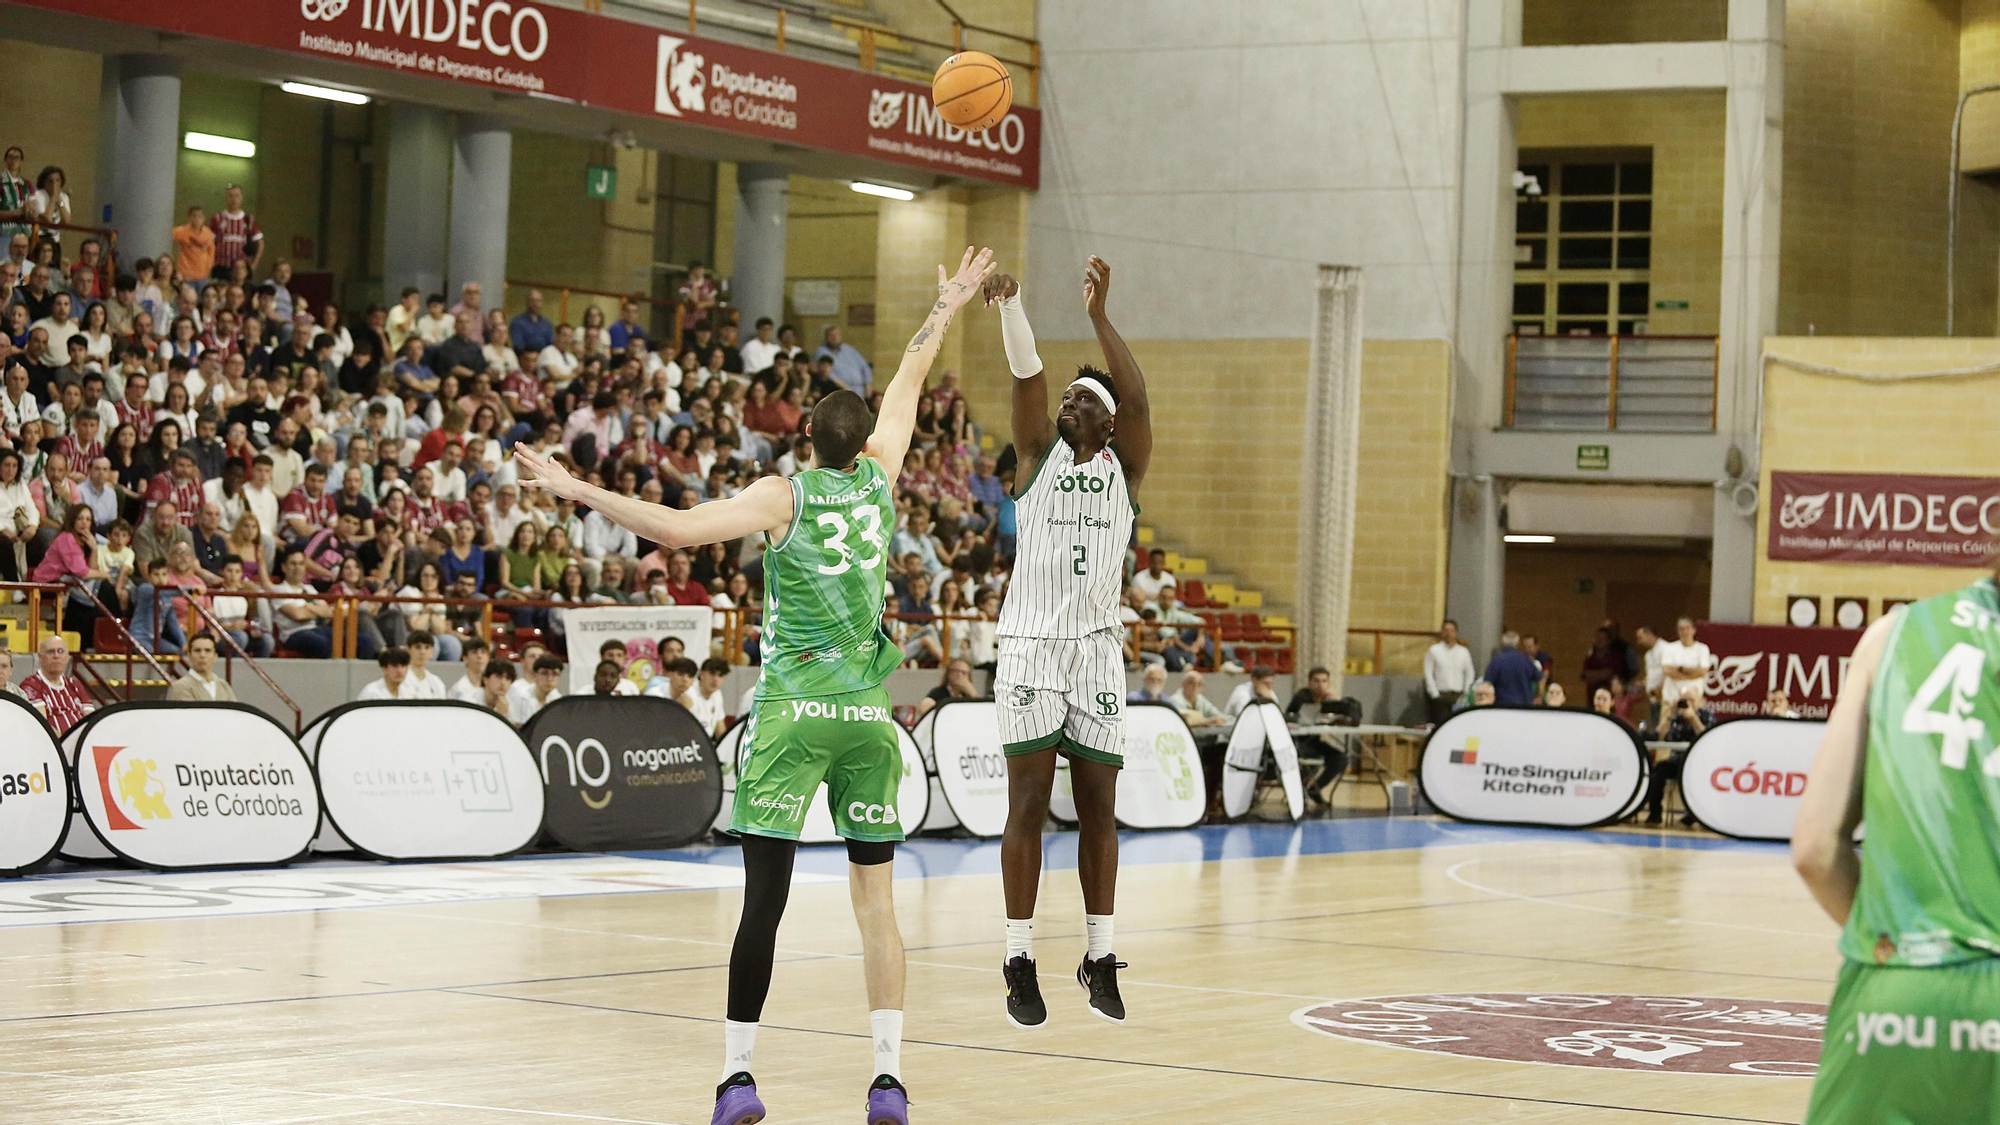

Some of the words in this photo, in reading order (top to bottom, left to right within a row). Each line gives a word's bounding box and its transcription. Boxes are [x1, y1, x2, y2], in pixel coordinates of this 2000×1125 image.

[361, 0, 549, 62] IMDECO
[300, 30, 353, 56] Instituto
[354, 42, 417, 69] Municipal
[418, 53, 436, 71] de
[436, 58, 493, 83] Deportes
[711, 63, 797, 102] Diputación
[710, 93, 732, 117] de
[733, 95, 797, 130] Córdoba
[596, 169, 609, 194] J
[817, 505, 884, 576] 33
[1887, 537, 1904, 551] de
[1072, 544, 1087, 576] 2
[623, 739, 703, 771] nogomet
[0, 763, 51, 797] asol
[175, 763, 295, 792] Diputación
[353, 768, 434, 785] CLÍNICA
[626, 769, 707, 787] comunicación
[1482, 779, 1566, 796] Kitchen
[1710, 760, 1808, 798] CÓRD
[183, 794, 208, 818] de
[214, 792, 303, 817] Córdoba
[1950, 1018, 2000, 1053] ne
